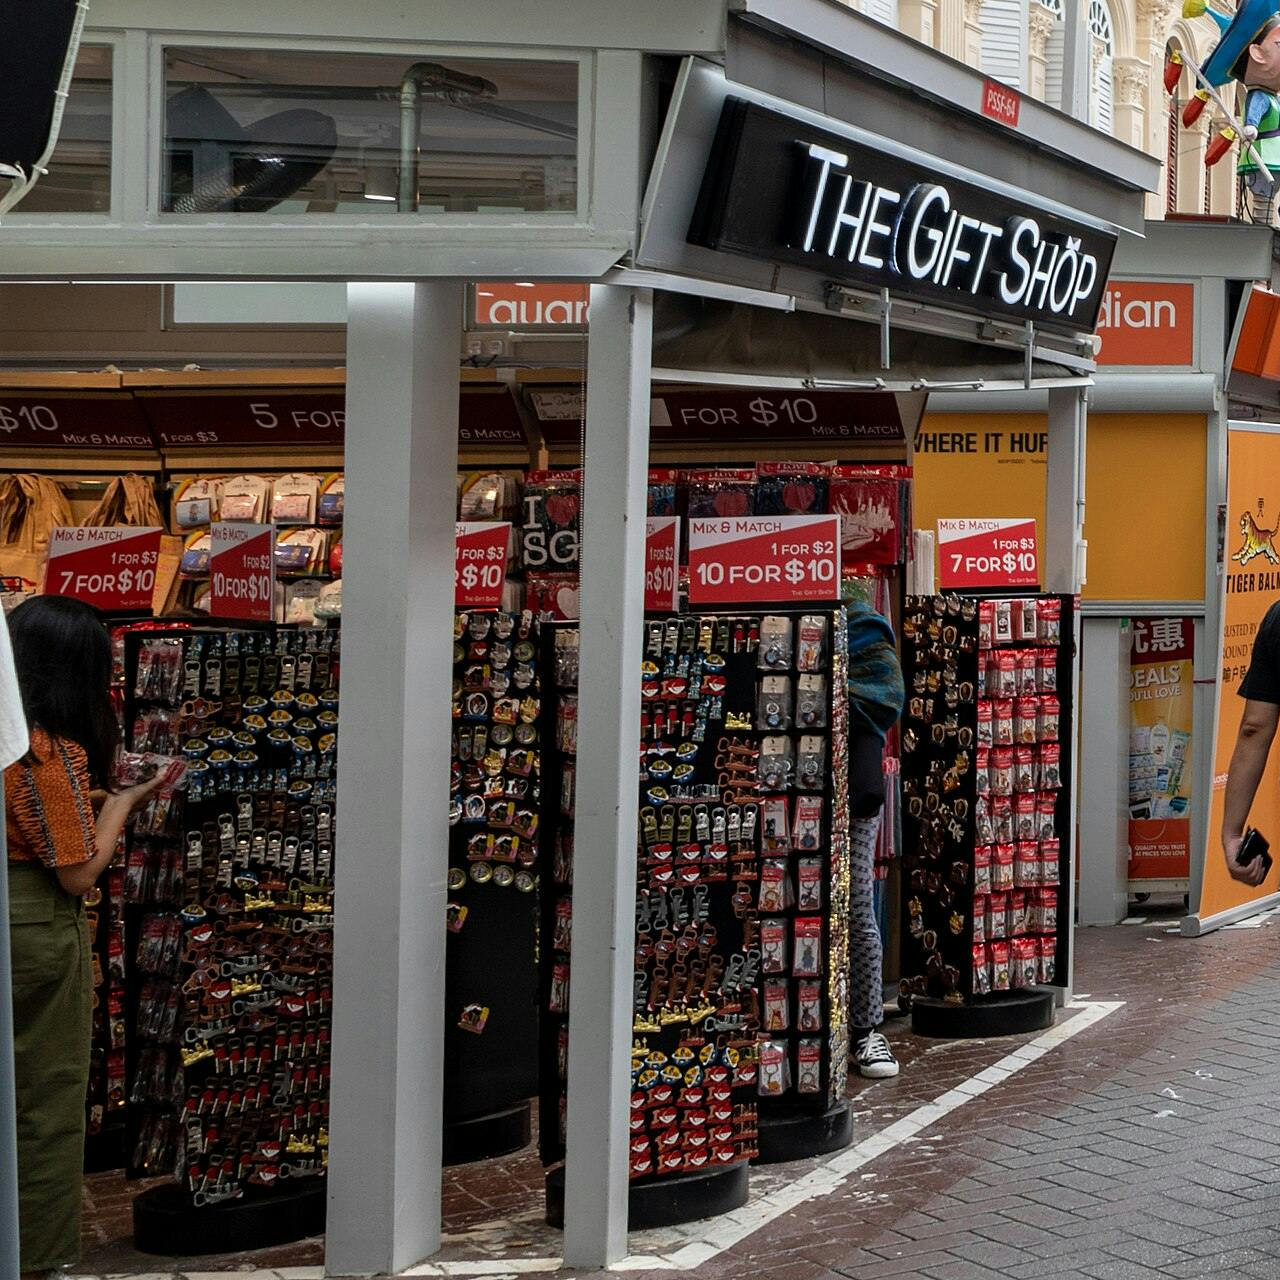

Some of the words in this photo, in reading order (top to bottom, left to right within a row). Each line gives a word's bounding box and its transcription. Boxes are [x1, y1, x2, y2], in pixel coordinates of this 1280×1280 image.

[986, 88, 1017, 119] PSSF-64
[803, 144, 900, 269] THE
[906, 184, 1003, 295] GIFT
[1000, 218, 1098, 316] SHOP
[249, 403, 278, 430] 5
[680, 407, 740, 426] FOR
[750, 396, 818, 428] $10
[171, 434, 194, 443] FOR
[196, 431, 218, 443] $3
[473, 428, 521, 439] MATCH
[812, 425, 837, 436] MIX
[840, 424, 850, 436] &
[853, 424, 900, 436] MATCH
[62, 433, 87, 445] MIX
[90, 434, 101, 445] &
[104, 433, 153, 446] MATCH
[984, 432, 1003, 453] IT
[524, 496, 542, 529] I
[693, 522, 717, 535] MIX
[720, 521, 731, 533] &
[736, 521, 782, 533] MATCH
[940, 521, 957, 530] MIX
[958, 520, 966, 530] &
[968, 521, 1000, 530] MATCH
[54, 530, 75, 542] MIX
[76, 530, 85, 541] &
[87, 529, 123, 541] MATCH
[212, 528, 221, 541] MIX
[228, 528, 249, 542] MATCH
[993, 538, 998, 549] 1
[1000, 540, 1018, 549] FOR
[1020, 537, 1035, 550] $3
[462, 548, 485, 559] FOR
[487, 545, 505, 561] $3
[524, 529, 580, 566] SG
[771, 543, 777, 555] 1
[781, 543, 809, 554] FOR
[812, 541, 834, 555] $2
[111, 552, 117, 564] 1
[118, 553, 140, 564] FOR
[141, 551, 157, 565] $3
[248, 556, 260, 567] FOR
[260, 554, 270, 569] $2
[951, 554, 963, 573] 7
[966, 556, 1001, 573] FOR
[1003, 552, 1036, 574] $10
[462, 565, 502, 590] $10
[653, 564, 674, 594] $10
[696, 562, 725, 586] 10
[729, 565, 782, 585] FOR
[784, 557, 835, 585] $10
[59, 571, 75, 595] 7
[75, 574, 115, 594] FOR
[118, 570, 154, 595] $10
[213, 576, 225, 597] 10
[226, 578, 248, 598] FOR
[249, 575, 270, 602] $10
[1226, 572, 1256, 595] TIGER
[1154, 686, 1181, 699] LOVE
